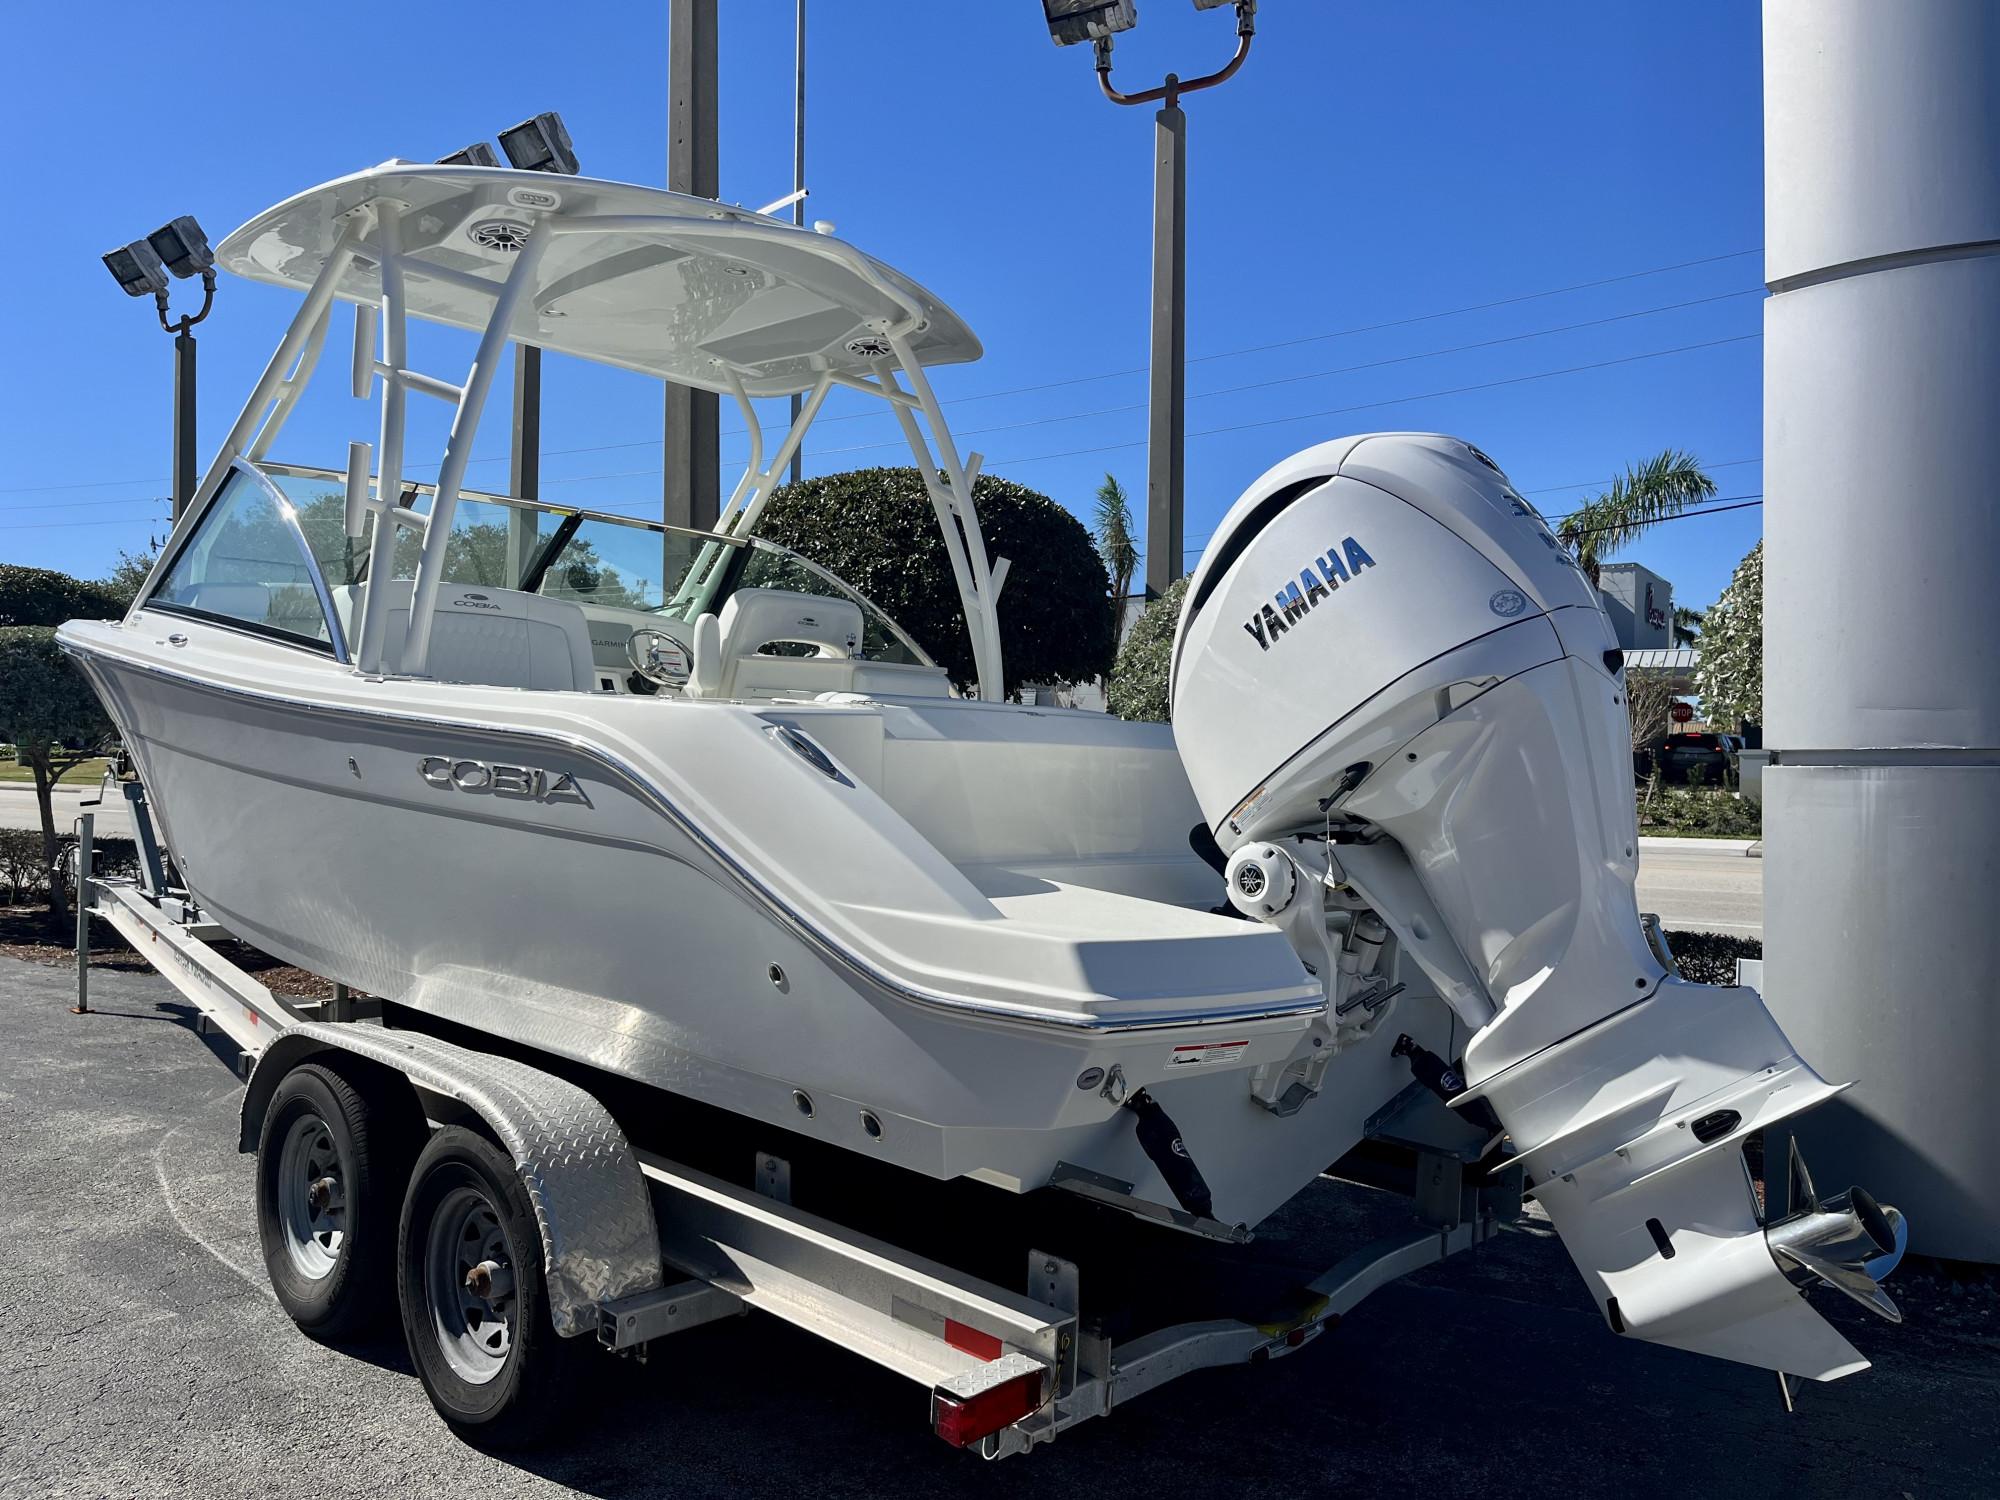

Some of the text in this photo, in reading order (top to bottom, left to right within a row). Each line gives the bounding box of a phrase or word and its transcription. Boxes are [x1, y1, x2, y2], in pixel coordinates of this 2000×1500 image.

[453, 600, 501, 611] COBIA
[1243, 536, 1377, 652] YAMAHA
[591, 639, 628, 649] GARMIN
[417, 755, 595, 810] COBIA
